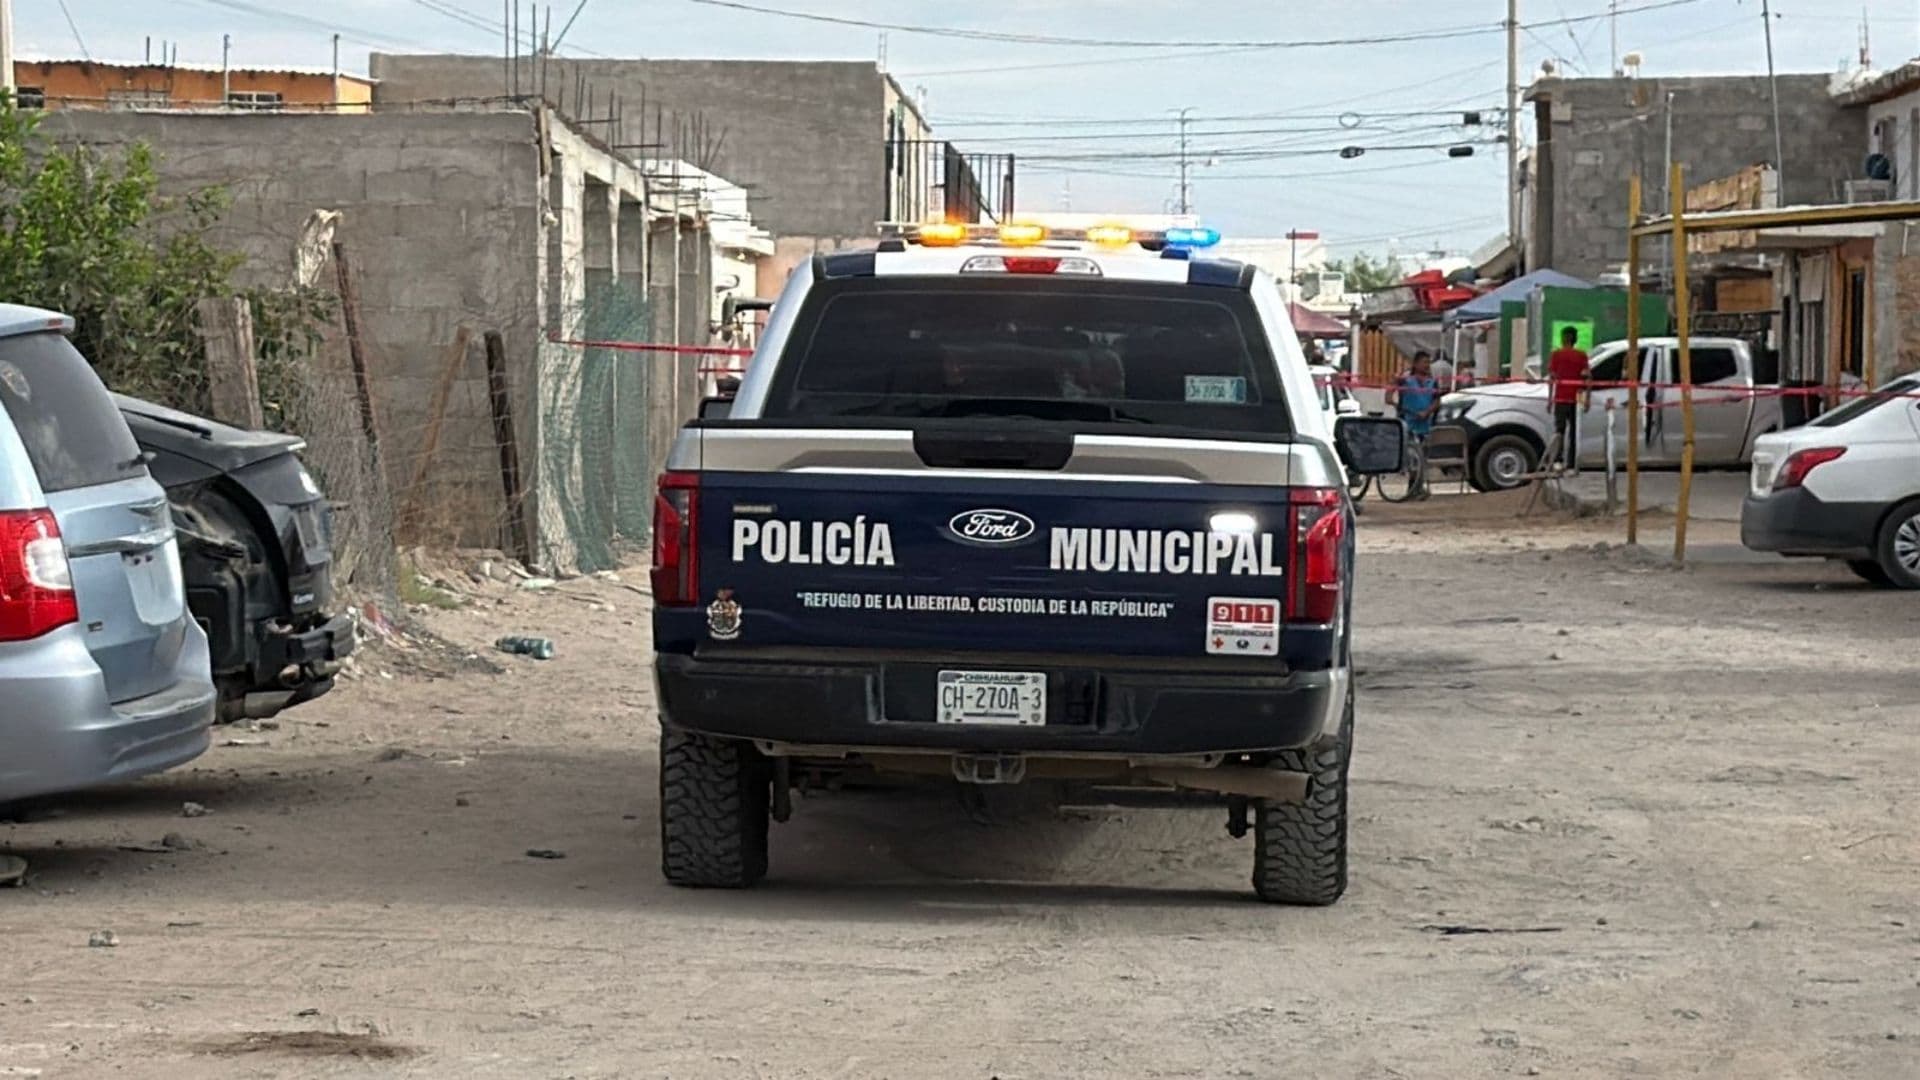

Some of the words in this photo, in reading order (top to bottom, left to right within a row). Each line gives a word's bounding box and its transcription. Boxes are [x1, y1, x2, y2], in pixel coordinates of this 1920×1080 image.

[964, 513, 1020, 537] Ford
[733, 515, 895, 566] POLICÍA
[1051, 527, 1283, 576] MUNICIPAL
[865, 594, 882, 609] DE
[886, 595, 903, 610] LA
[906, 595, 975, 613] LIBERTAD,
[979, 597, 1046, 614] CUSTODIA
[1049, 599, 1067, 614] DE
[1070, 600, 1088, 615] LA
[942, 685, 1042, 710] CH-270A-3
